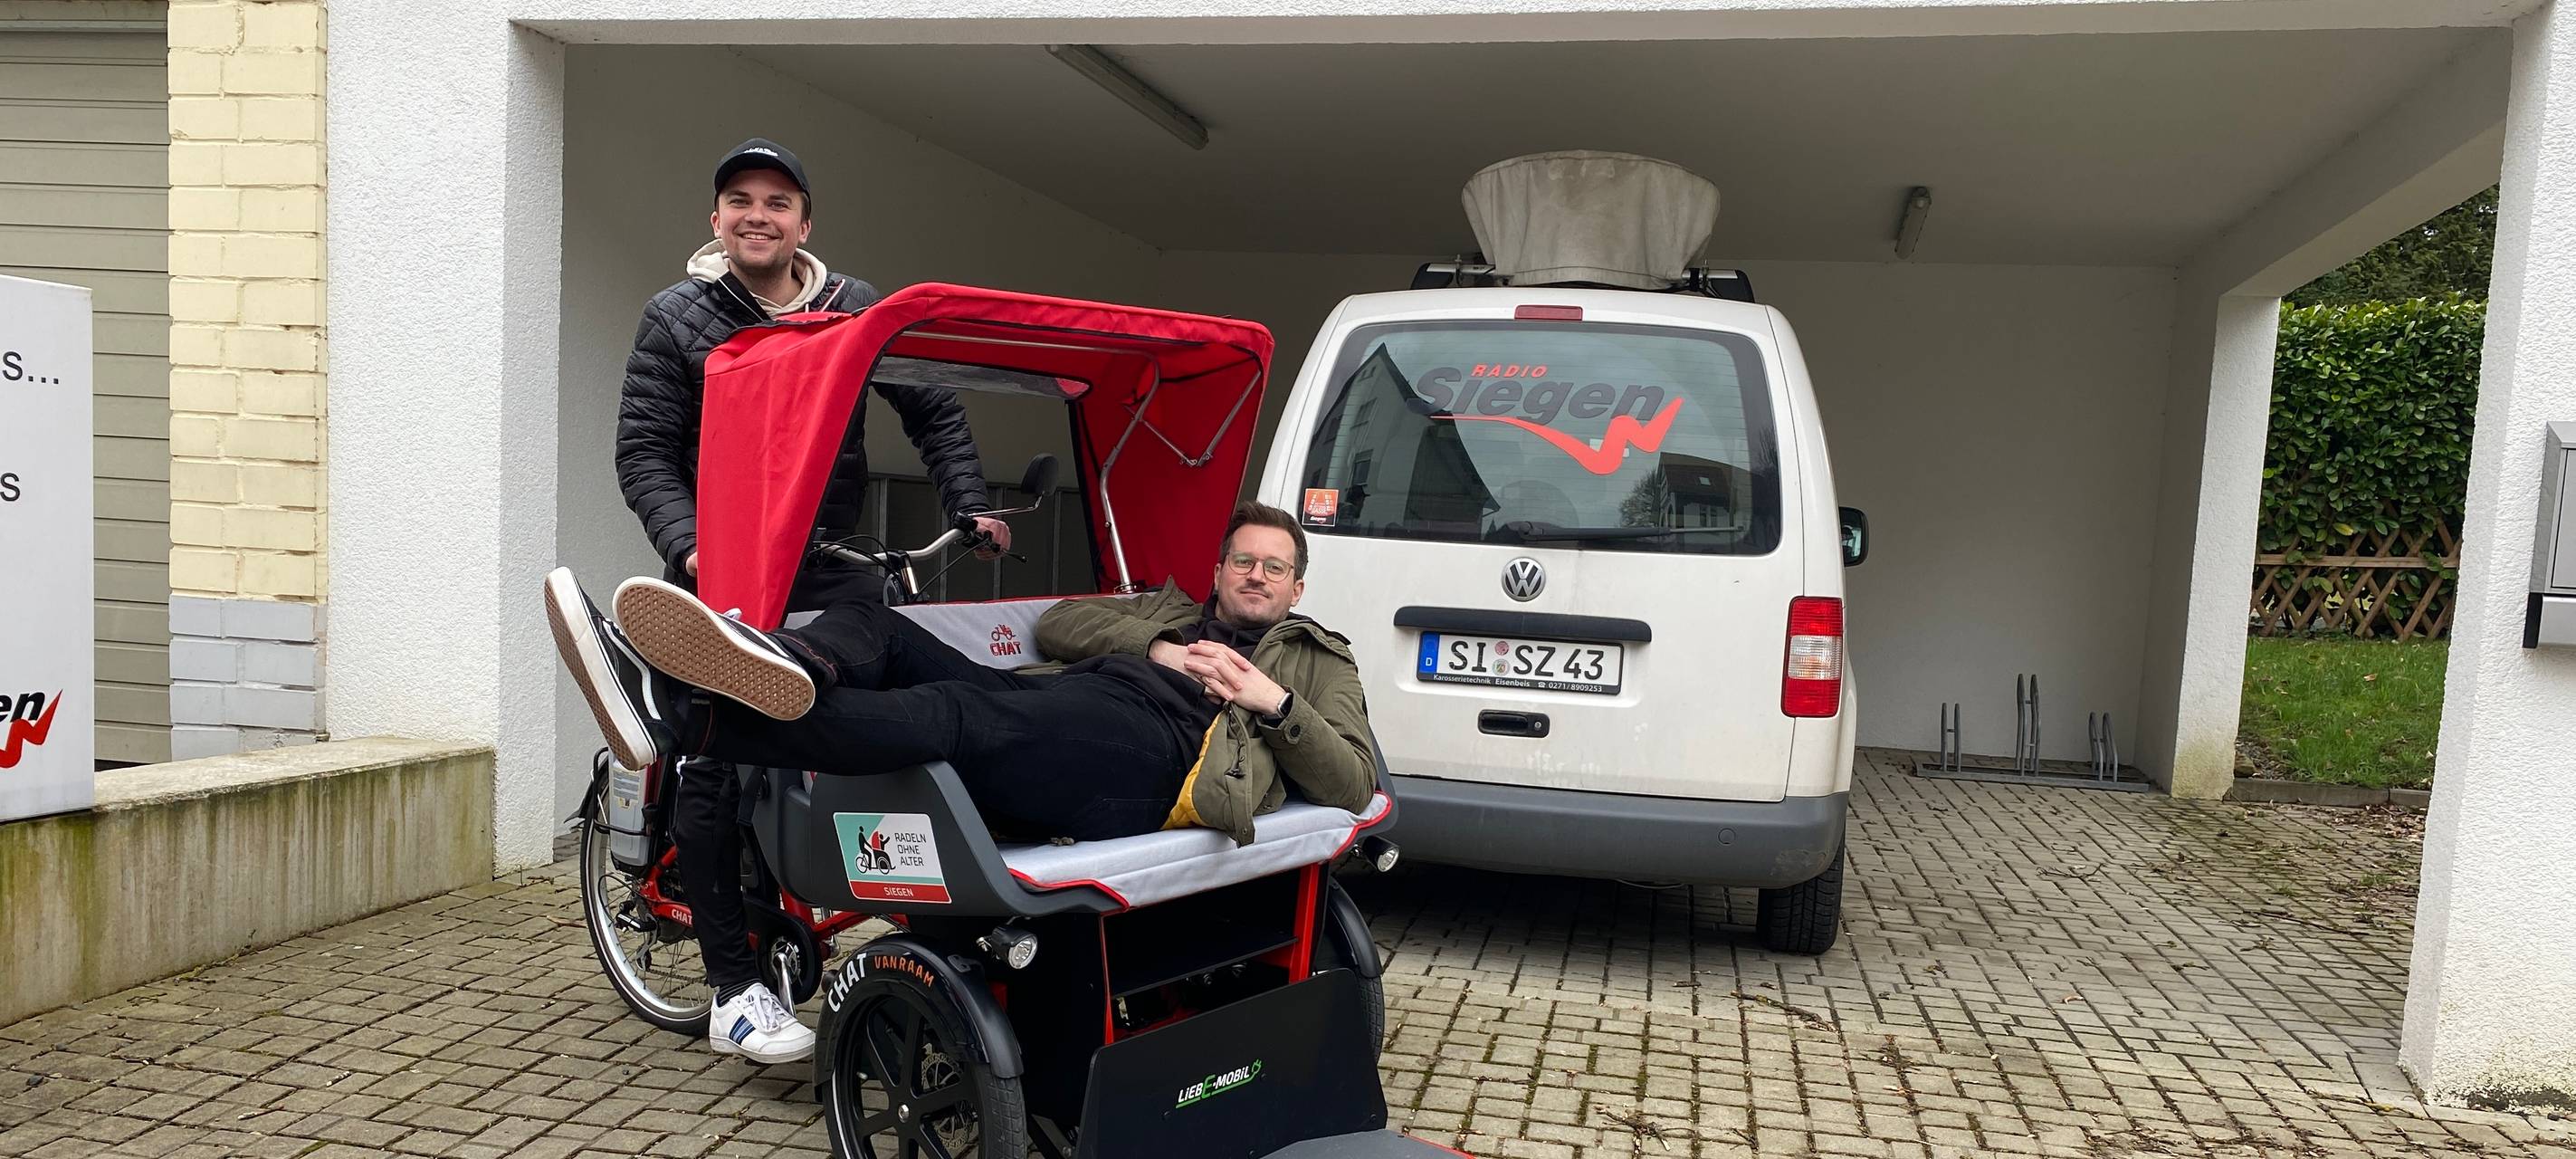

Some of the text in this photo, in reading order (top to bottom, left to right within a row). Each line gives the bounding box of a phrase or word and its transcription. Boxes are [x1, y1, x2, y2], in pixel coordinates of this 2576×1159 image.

[1471, 363, 1549, 378] RADIO
[1405, 366, 1665, 426] Siegen
[989, 641, 1022, 656] CHAT
[1425, 656, 1433, 667] D
[1448, 640, 1605, 680] SI SZ 43
[1433, 674, 1602, 693] Karosserietechnik Eisenbeis 0271/8909253
[894, 832, 927, 844] RADELN
[897, 844, 921, 855] OHNE
[900, 856, 925, 867] ALTER
[883, 886, 914, 897] SIEGEN
[827, 953, 936, 1012] CHAT VANRAAM
